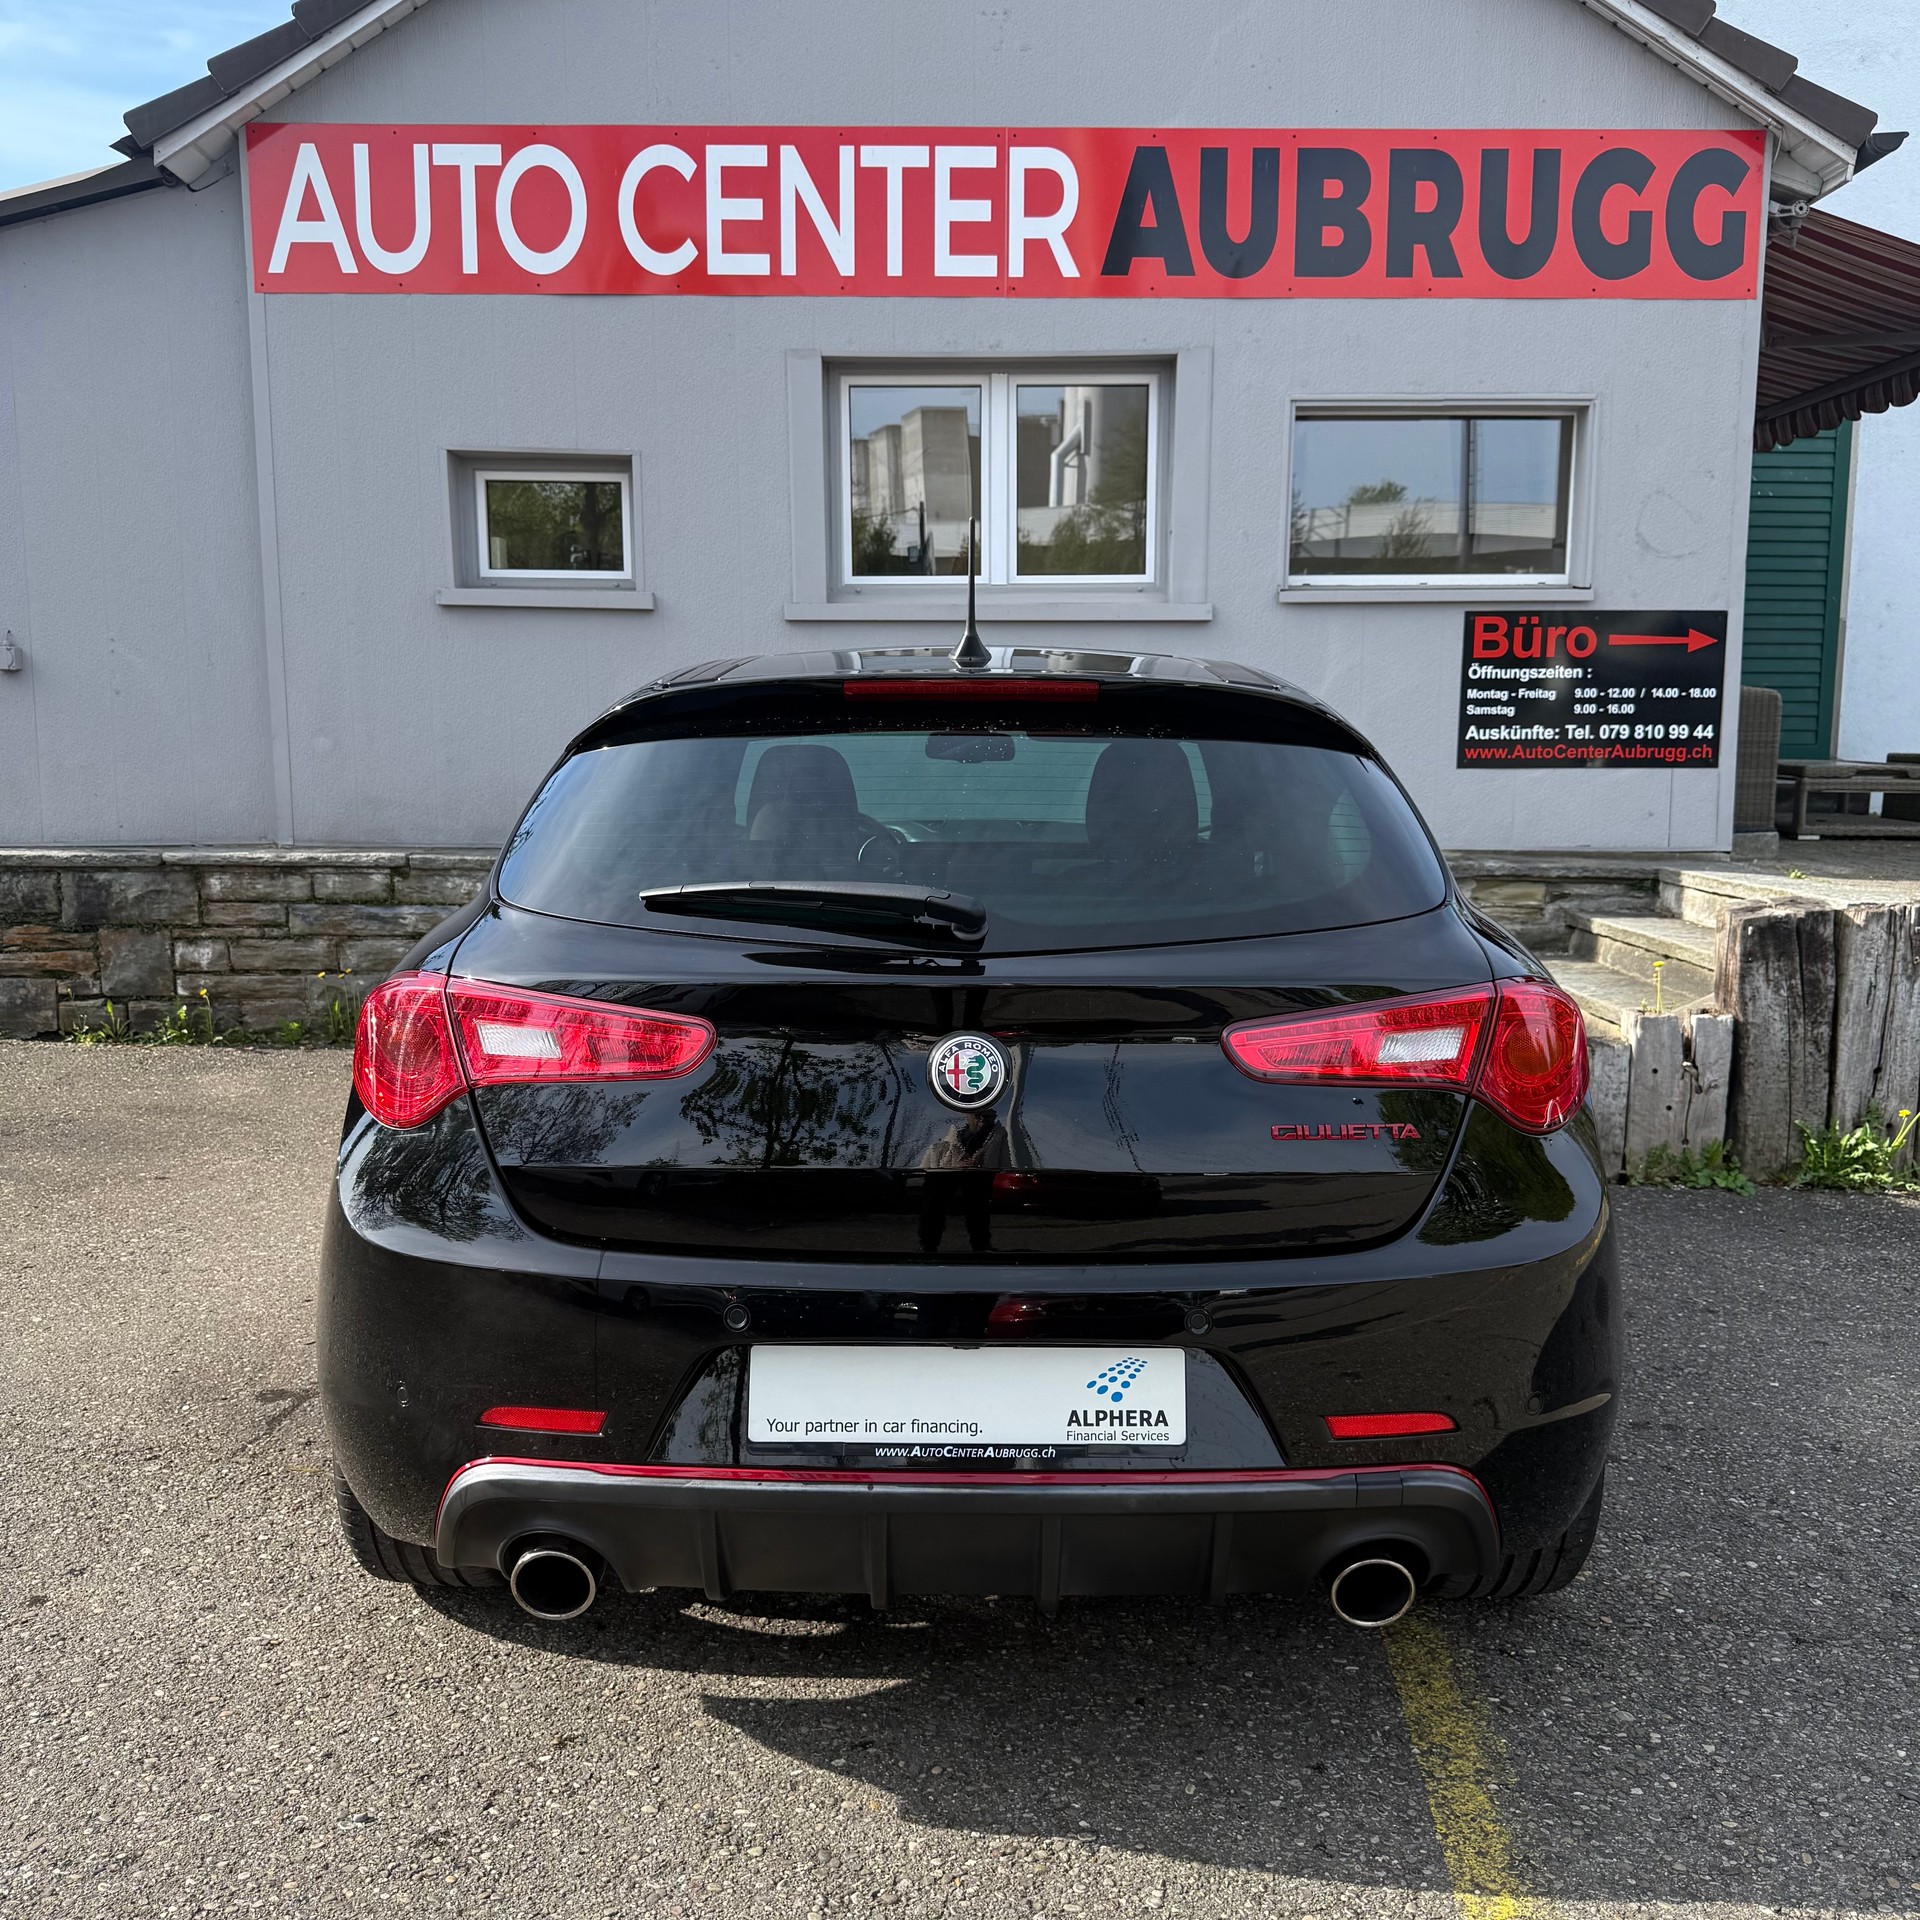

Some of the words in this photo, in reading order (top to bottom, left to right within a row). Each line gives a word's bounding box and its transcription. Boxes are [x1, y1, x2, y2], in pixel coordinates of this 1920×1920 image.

[267, 143, 588, 276] AUTO
[617, 143, 1081, 278] CENTER
[1100, 145, 1751, 281] AUBRUGG
[1472, 616, 1597, 659] Büro
[1468, 663, 1583, 682] Öffnungszeiten
[1467, 689, 1509, 700] Montag
[1518, 689, 1557, 700] Freitag
[1574, 688, 1597, 698] 9.00
[1608, 688, 1635, 698] 12.00
[1651, 688, 1679, 698] 14.00
[1689, 688, 1717, 698] 18.00
[1466, 705, 1516, 717] Samstag
[1573, 704, 1596, 714] 9.00
[1607, 704, 1635, 714] 16.00
[1465, 725, 1560, 740] Auskünfte:
[1565, 725, 1594, 740] Tel.
[1599, 725, 1629, 740] 079
[1634, 724, 1664, 739] 810
[1668, 724, 1690, 739] 99
[1693, 724, 1714, 739] 44
[1465, 744, 1712, 762] www.AutoCenterAubrugg.ch
[939, 1046, 959, 1072] ALFA
[964, 1042, 998, 1072] ROMEO
[1271, 1123, 1422, 1141] GIULIETTA
[766, 1418, 801, 1433] Your
[805, 1420, 859, 1436] partner
[864, 1419, 878, 1433] in
[882, 1422, 905, 1433] car
[911, 1418, 983, 1436] financing.
[1066, 1409, 1169, 1427] ALPHERA
[1066, 1430, 1116, 1441] Financial
[1121, 1430, 1169, 1441] Services
